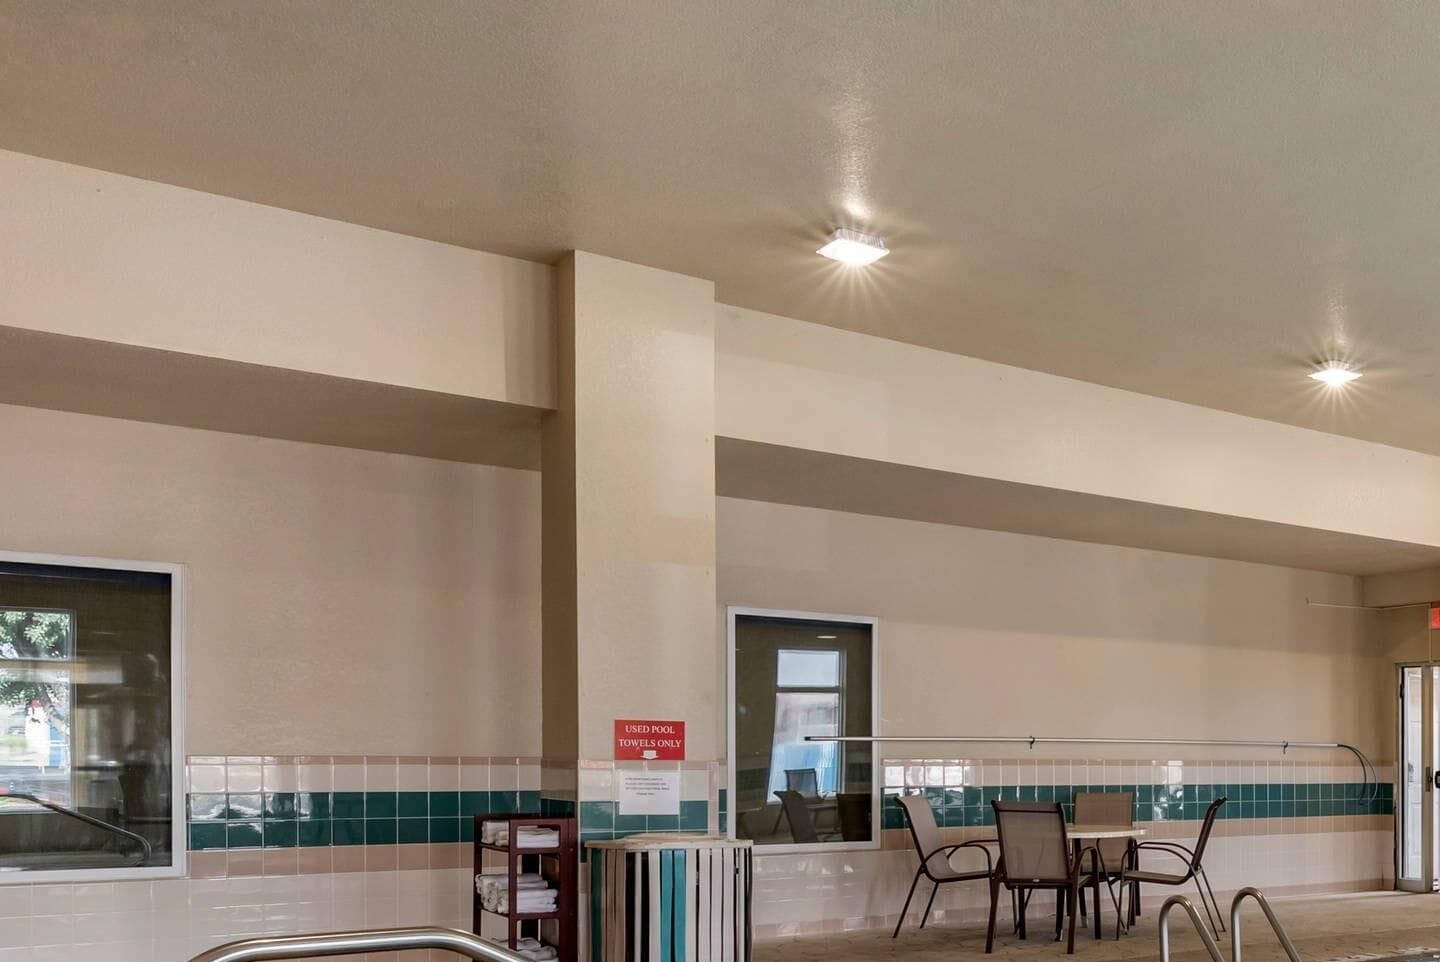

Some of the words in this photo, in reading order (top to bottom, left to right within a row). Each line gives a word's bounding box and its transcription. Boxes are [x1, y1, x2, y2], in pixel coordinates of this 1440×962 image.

[625, 725, 649, 734] USED
[651, 725, 676, 734] POOL
[619, 739, 656, 747] TOWELS
[657, 739, 681, 748] ONLY
